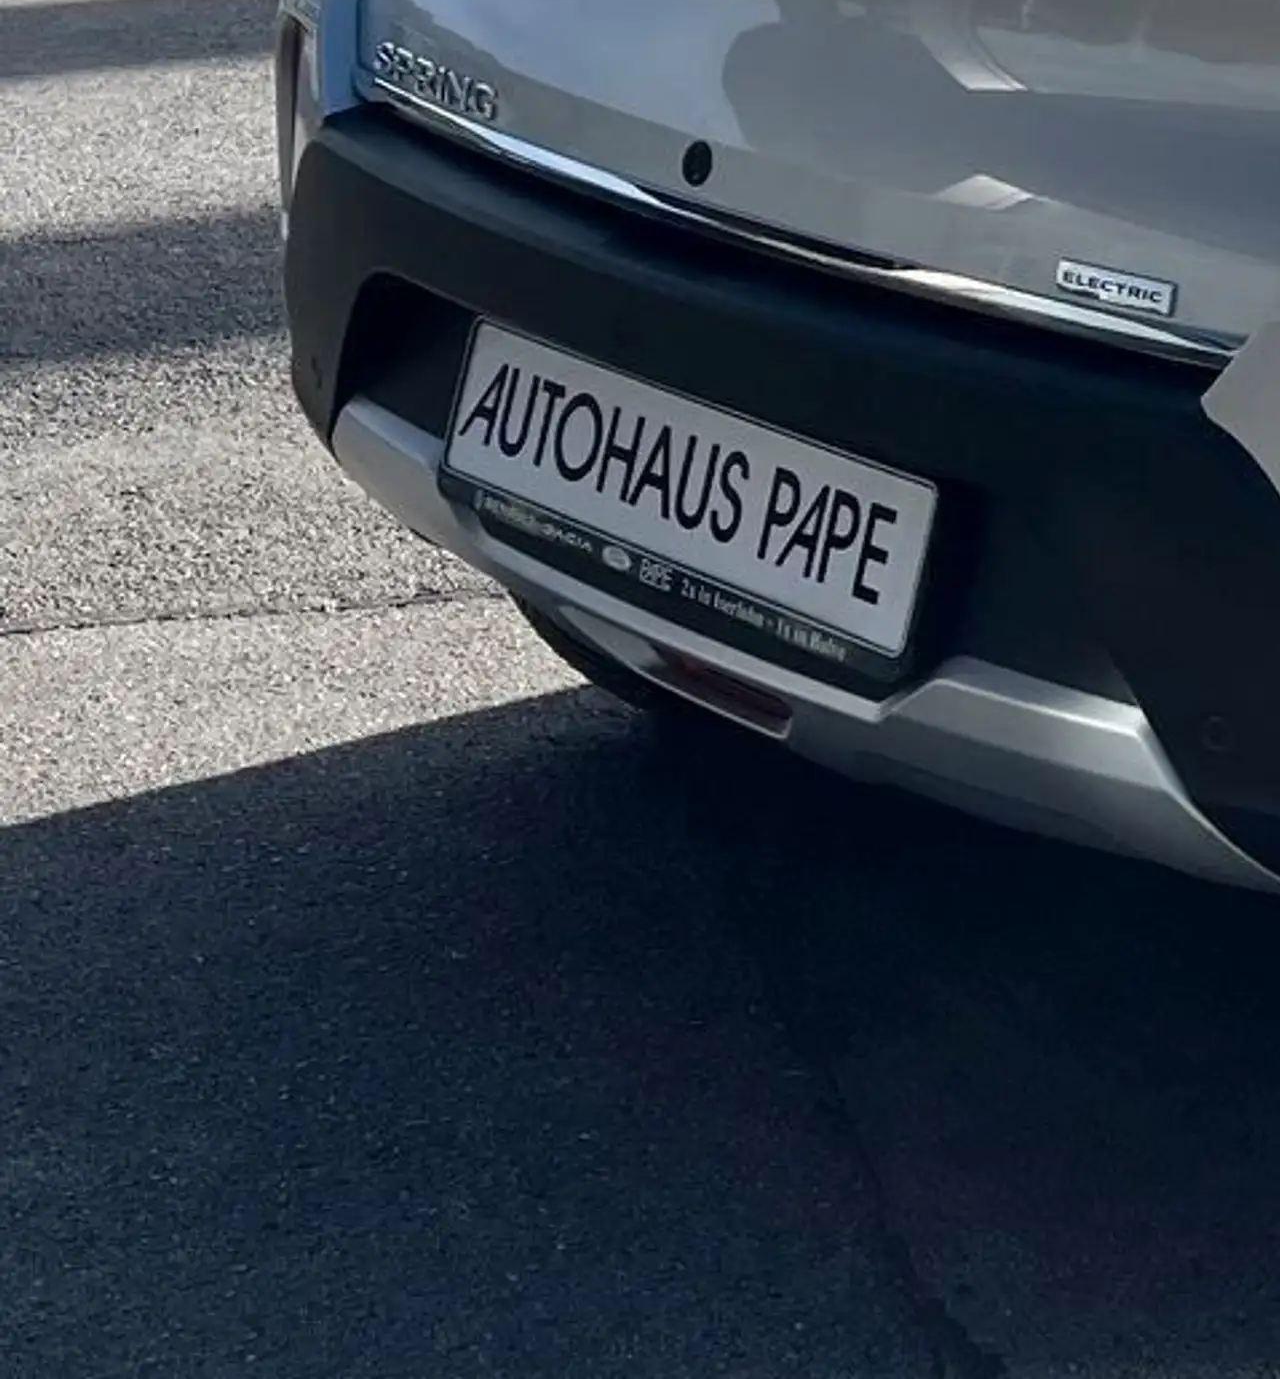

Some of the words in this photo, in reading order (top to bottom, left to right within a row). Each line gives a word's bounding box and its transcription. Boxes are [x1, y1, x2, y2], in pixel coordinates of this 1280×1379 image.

[373, 41, 499, 121] SPRING
[1062, 270, 1164, 304] ELECTRIC
[458, 362, 751, 543] AUTOHAUS
[756, 466, 898, 606] PAPE
